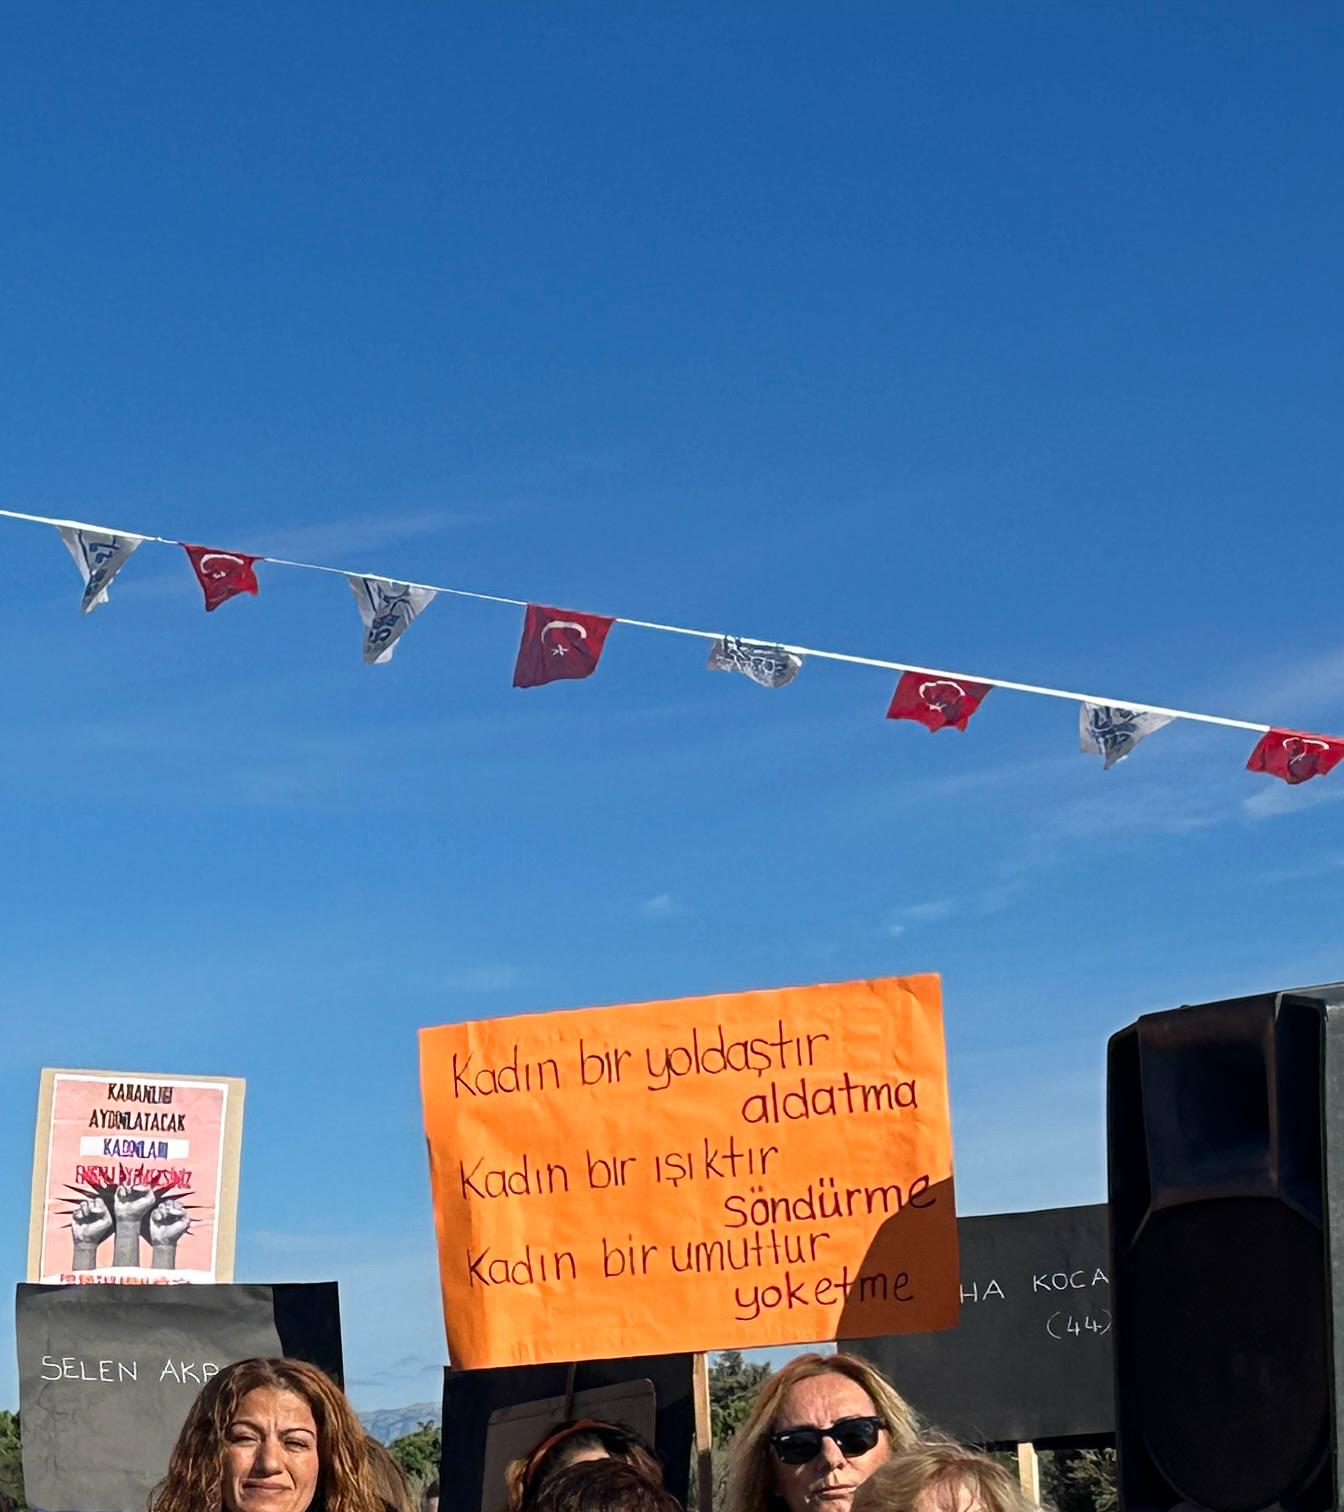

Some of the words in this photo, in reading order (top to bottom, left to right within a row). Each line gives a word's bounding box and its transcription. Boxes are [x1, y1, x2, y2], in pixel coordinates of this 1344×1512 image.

[451, 1043, 561, 1098] Kadın
[645, 1019, 830, 1091] yoldaştır
[741, 1071, 918, 1124] aldatma
[460, 1153, 569, 1200] Kadın
[723, 1174, 937, 1229] söndürme
[466, 1244, 577, 1288] Kadın
[601, 1233, 658, 1279] bir
[670, 1228, 831, 1273] umuttur
[959, 1279, 1006, 1304] HA
[1046, 1307, 1112, 1339] (44)
[40, 1354, 138, 1384] SELEN
